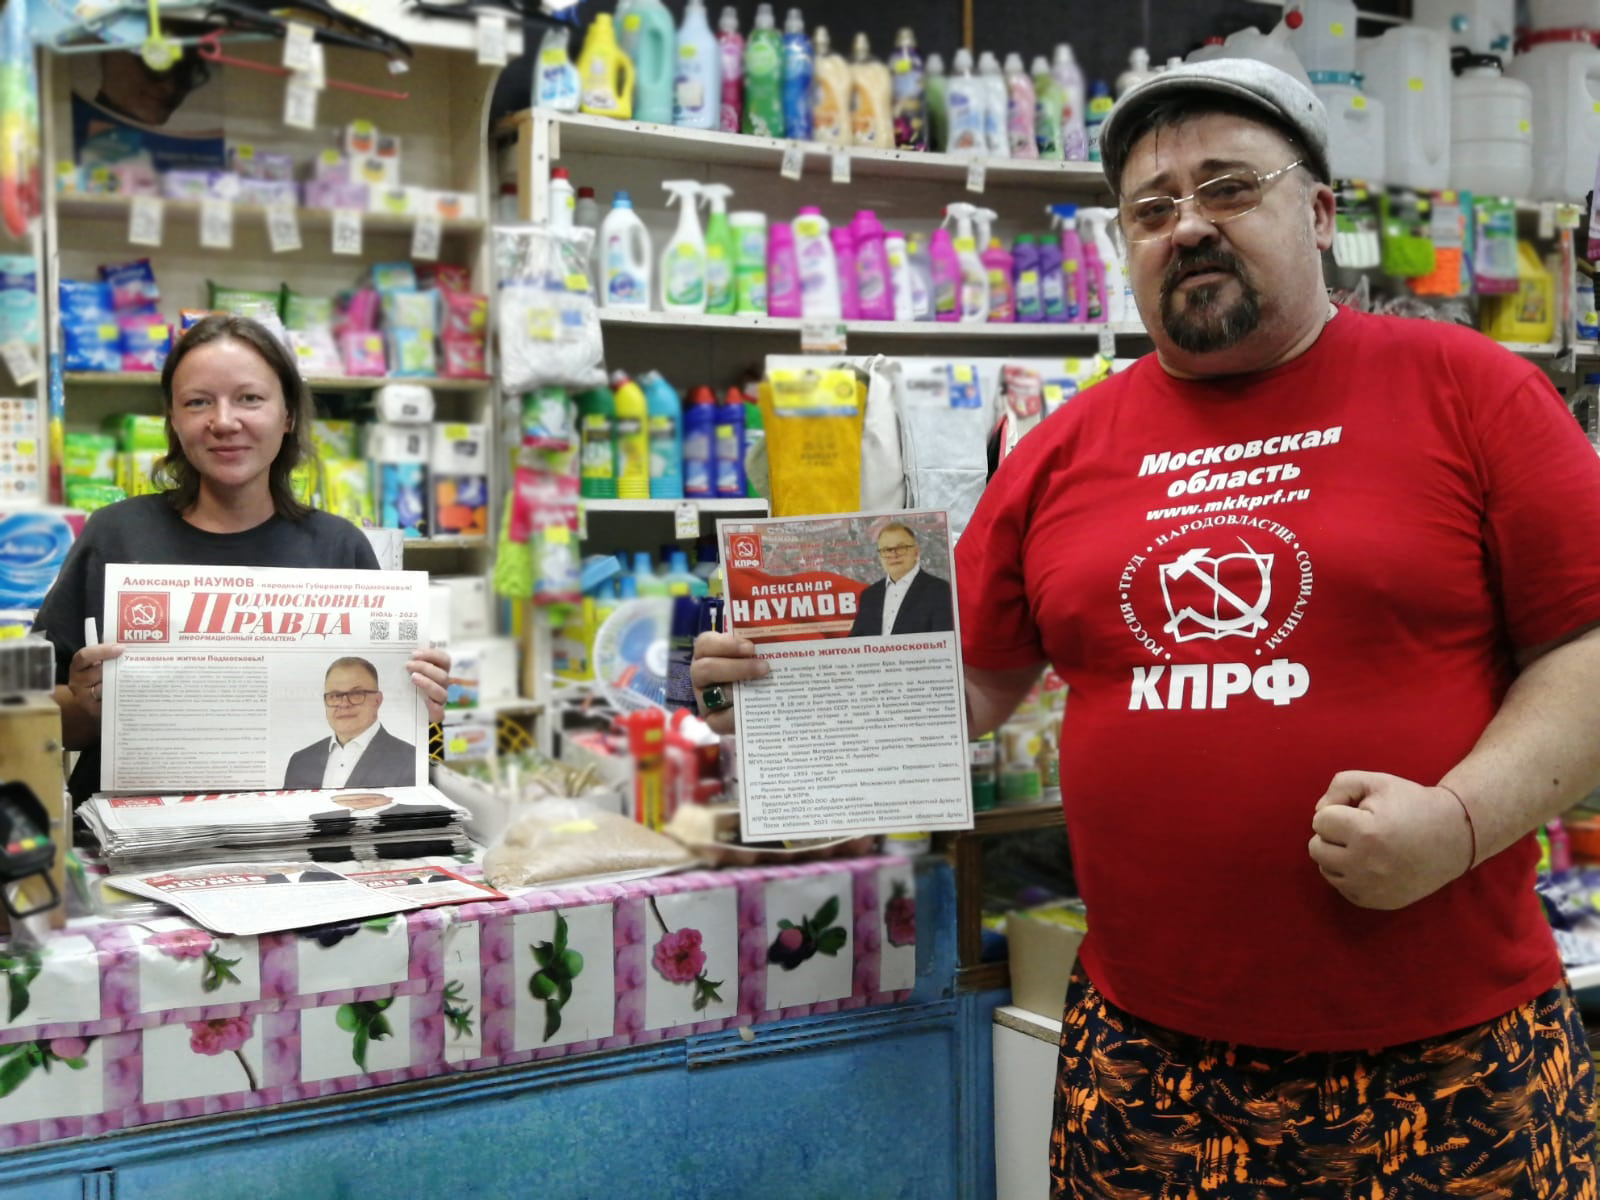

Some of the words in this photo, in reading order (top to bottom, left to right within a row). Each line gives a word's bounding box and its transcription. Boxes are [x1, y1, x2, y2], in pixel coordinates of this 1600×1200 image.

[1138, 426, 1343, 477] Московская
[1168, 463, 1300, 498] область
[1146, 488, 1311, 521] www.mkkprf.ru
[1155, 514, 1297, 547] НАРОДОВЛАСТИЕ
[734, 559, 760, 568] КПРФ
[1119, 554, 1147, 591] ТРУД
[123, 576, 191, 588] Александр
[194, 576, 255, 588] НАУМОВ
[751, 580, 833, 596] АЛЕКСАНДР
[732, 591, 857, 622] НАУМОВ
[1265, 550, 1314, 651] СОЦИАЛИЗМ
[123, 629, 163, 641] КПРФ
[1119, 602, 1165, 657] РОССИЯ
[751, 648, 816, 661] важаемые
[818, 645, 861, 658] жители
[863, 639, 948, 655] Подмосковья!
[1128, 658, 1311, 710] КПРФ
[1466, 1114, 1499, 1137] SPORT
